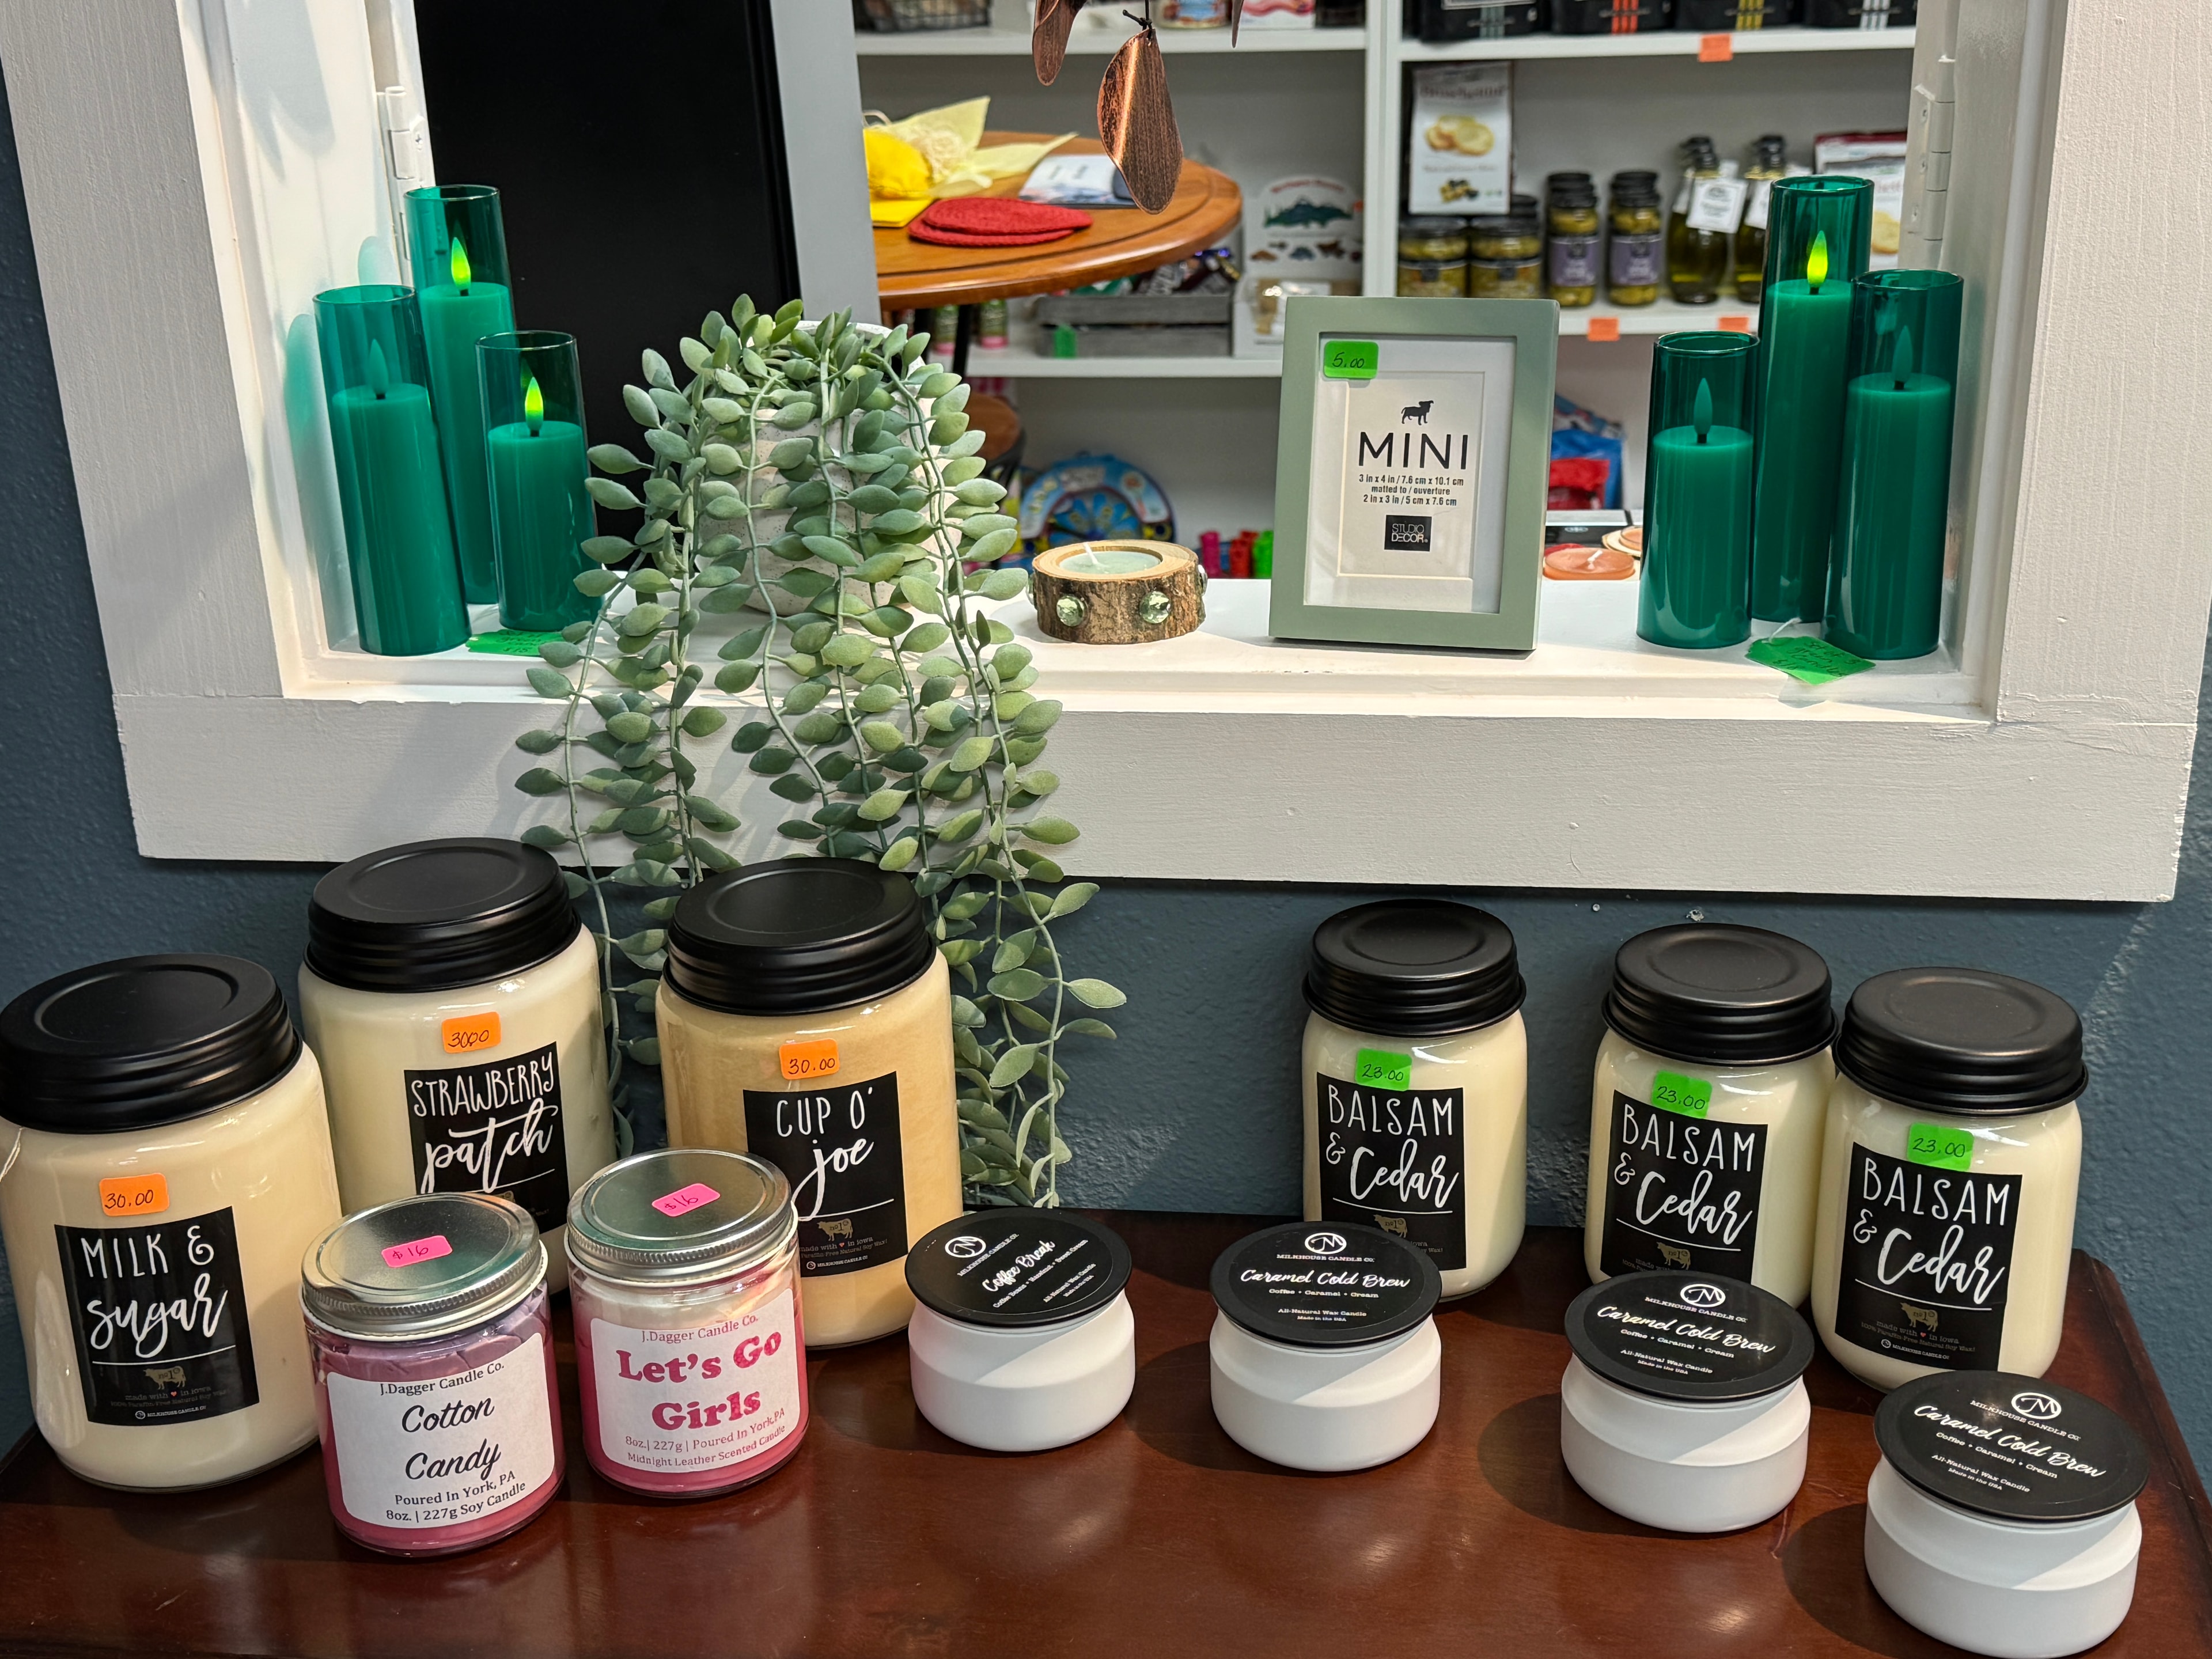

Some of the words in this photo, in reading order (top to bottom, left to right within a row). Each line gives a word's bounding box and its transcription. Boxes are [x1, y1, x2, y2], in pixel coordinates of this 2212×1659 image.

[1332, 352, 1365, 368] 5.00
[1359, 431, 1468, 469] MINI
[1366, 474, 1372, 482] in
[1381, 475, 1385, 483] 4
[1388, 475, 1395, 483] in
[1402, 476, 1412, 484] 7.6
[1435, 477, 1449, 485] 10.1
[1370, 495, 1377, 503] in
[1392, 495, 1399, 503] in
[1406, 496, 1410, 504] 5
[1392, 524, 1424, 533] STUDIO
[411, 1052, 553, 1116] STRAWBERRY
[788, 1058, 835, 1074] 30.00
[1362, 1064, 1404, 1081] 23.00
[777, 1097, 831, 1137] CUP
[850, 1087, 873, 1130] O'
[1328, 1084, 1452, 1137] BALSAM
[1656, 1086, 1705, 1109] 23.00
[421, 1098, 558, 1194] patch
[1623, 1104, 1755, 1172] BALSAM
[791, 1138, 874, 1221] joe
[1326, 1132, 1346, 1165] &
[1350, 1139, 1459, 1209] Cedar
[104, 1190, 154, 1209] 30.00
[1614, 1152, 1635, 1185] &
[1636, 1169, 1753, 1245] Cedar
[1863, 1158, 2009, 1226] BALSAM
[81, 1233, 168, 1279] MILK
[187, 1225, 214, 1265] &
[982, 1266, 1021, 1291] Coffee
[1015, 1240, 1055, 1268] Break
[1853, 1209, 1877, 1244] &
[1877, 1225, 2005, 1304] Cedar
[1240, 1269, 1315, 1283] Caramel
[1317, 1271, 1359, 1285] Cold
[1362, 1274, 1411, 1288] Brew
[87, 1273, 228, 1358] sugar
[1645, 1297, 1697, 1312] MILKHOUSE
[1699, 1309, 1734, 1320] CANDLE
[642, 1331, 694, 1343] J.Dagger
[698, 1321, 738, 1339] Candle
[743, 1315, 758, 1326] Co.
[1597, 1305, 1677, 1331] Caramel
[1676, 1324, 1724, 1340] Cold
[1722, 1334, 1777, 1353] Brew
[1621, 1330, 1647, 1339] Coffee
[1657, 1337, 1695, 1349] Caramel
[1705, 1348, 1734, 1358] Cream
[1900, 1328, 1917, 1336] with
[616, 1350, 721, 1382] Let's
[733, 1331, 782, 1369] Go
[1621, 1349, 1665, 1363] All-Natural
[1685, 1364, 1713, 1373] Candle
[381, 1383, 435, 1395] J.Dagger
[440, 1370, 483, 1388] Candle
[487, 1362, 504, 1374] Co.
[402, 1398, 495, 1432] Cotton
[652, 1391, 760, 1430] Girls
[1970, 1400, 2026, 1423] MILKHOUSE
[2027, 1421, 2067, 1437] CANDLE
[406, 1438, 501, 1480] Candy
[628, 1452, 673, 1467] Midnight
[675, 1456, 716, 1466] Leather
[719, 1440, 757, 1460] Scented
[759, 1425, 785, 1446] Candle
[654, 1440, 682, 1452] 227g
[694, 1432, 734, 1449] Poured
[737, 1430, 747, 1440] In
[1914, 1404, 2002, 1440] Caramel
[1998, 1435, 2052, 1457] Cold
[2047, 1452, 2107, 1478] Brew
[1936, 1432, 1965, 1446] Coffee
[1975, 1446, 2016, 1464] Caramel
[2026, 1464, 2057, 1478] Cream
[395, 1493, 442, 1505] Poured
[446, 1492, 459, 1501] In
[463, 1480, 496, 1498] York,
[499, 1471, 516, 1485] PA
[1932, 1454, 1979, 1474] All-Natural
[1982, 1471, 1999, 1482] Wax
[2001, 1479, 2030, 1492] Candle
[387, 1510, 411, 1521] 8oz.
[424, 1508, 457, 1519] 227g
[461, 1502, 483, 1514] Soy
[487, 1482, 525, 1506] Candle
